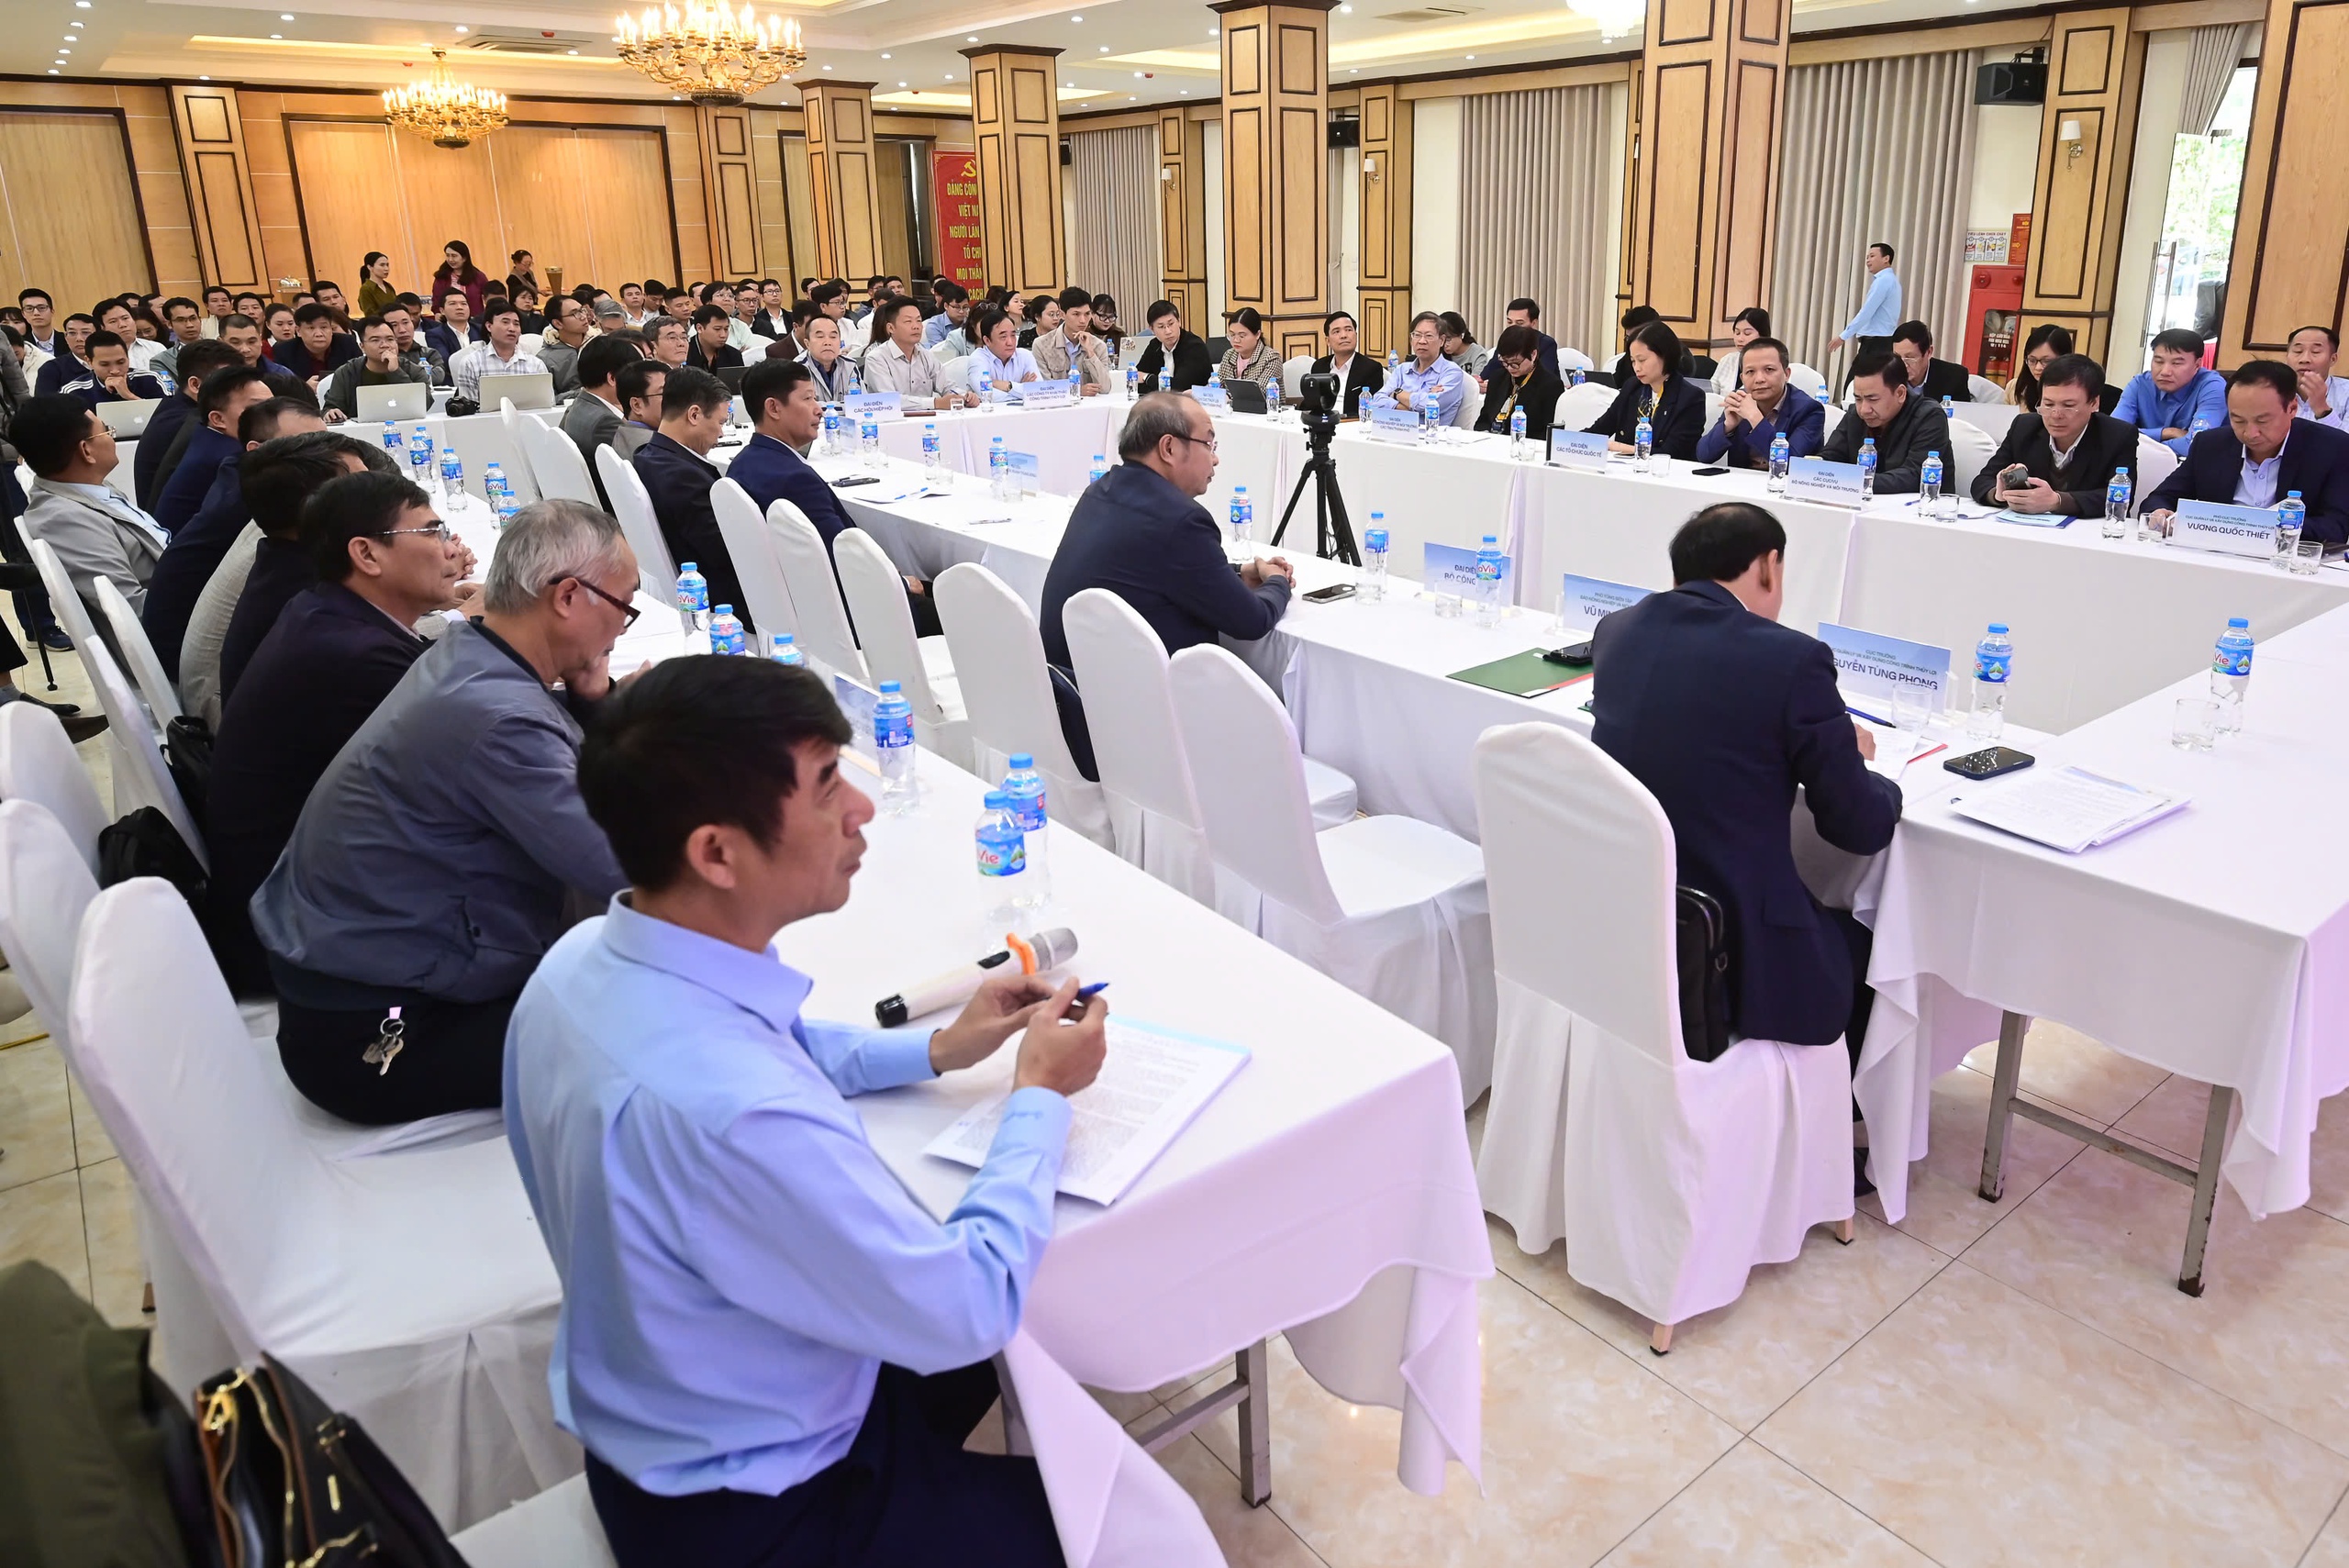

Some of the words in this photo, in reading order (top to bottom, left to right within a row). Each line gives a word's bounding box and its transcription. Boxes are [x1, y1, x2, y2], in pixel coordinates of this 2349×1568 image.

[947, 179, 963, 195] ĐẢNG
[964, 181, 977, 198] CỘN
[958, 202, 971, 220] VIỆT
[949, 223, 967, 238] NGƯỜI
[968, 223, 980, 238] LÃN
[963, 242, 970, 259] TỔ
[956, 268, 968, 283] MỌI
[969, 263, 982, 279] THẮN
[2187, 522, 2217, 532] VƯƠNG
[2218, 527, 2245, 536] QUỐC
[2245, 530, 2270, 539] THIẾT
[1465, 566, 1476, 574] DIỆ
[1478, 565, 1496, 573] aVie
[1456, 574, 1476, 585] CÔNG
[678, 595, 696, 604] aVie
[1584, 605, 1596, 616] VŨ
[1598, 608, 1611, 617] MI
[1876, 651, 1896, 660] TRƯỞNG
[2215, 653, 2229, 665] Vie
[1886, 659, 1900, 667] CÔNG
[1833, 658, 1866, 673] GUYỄN
[1868, 665, 1896, 680] TÙNG
[1898, 673, 1938, 690] PHONG
[979, 850, 999, 864] Vie
